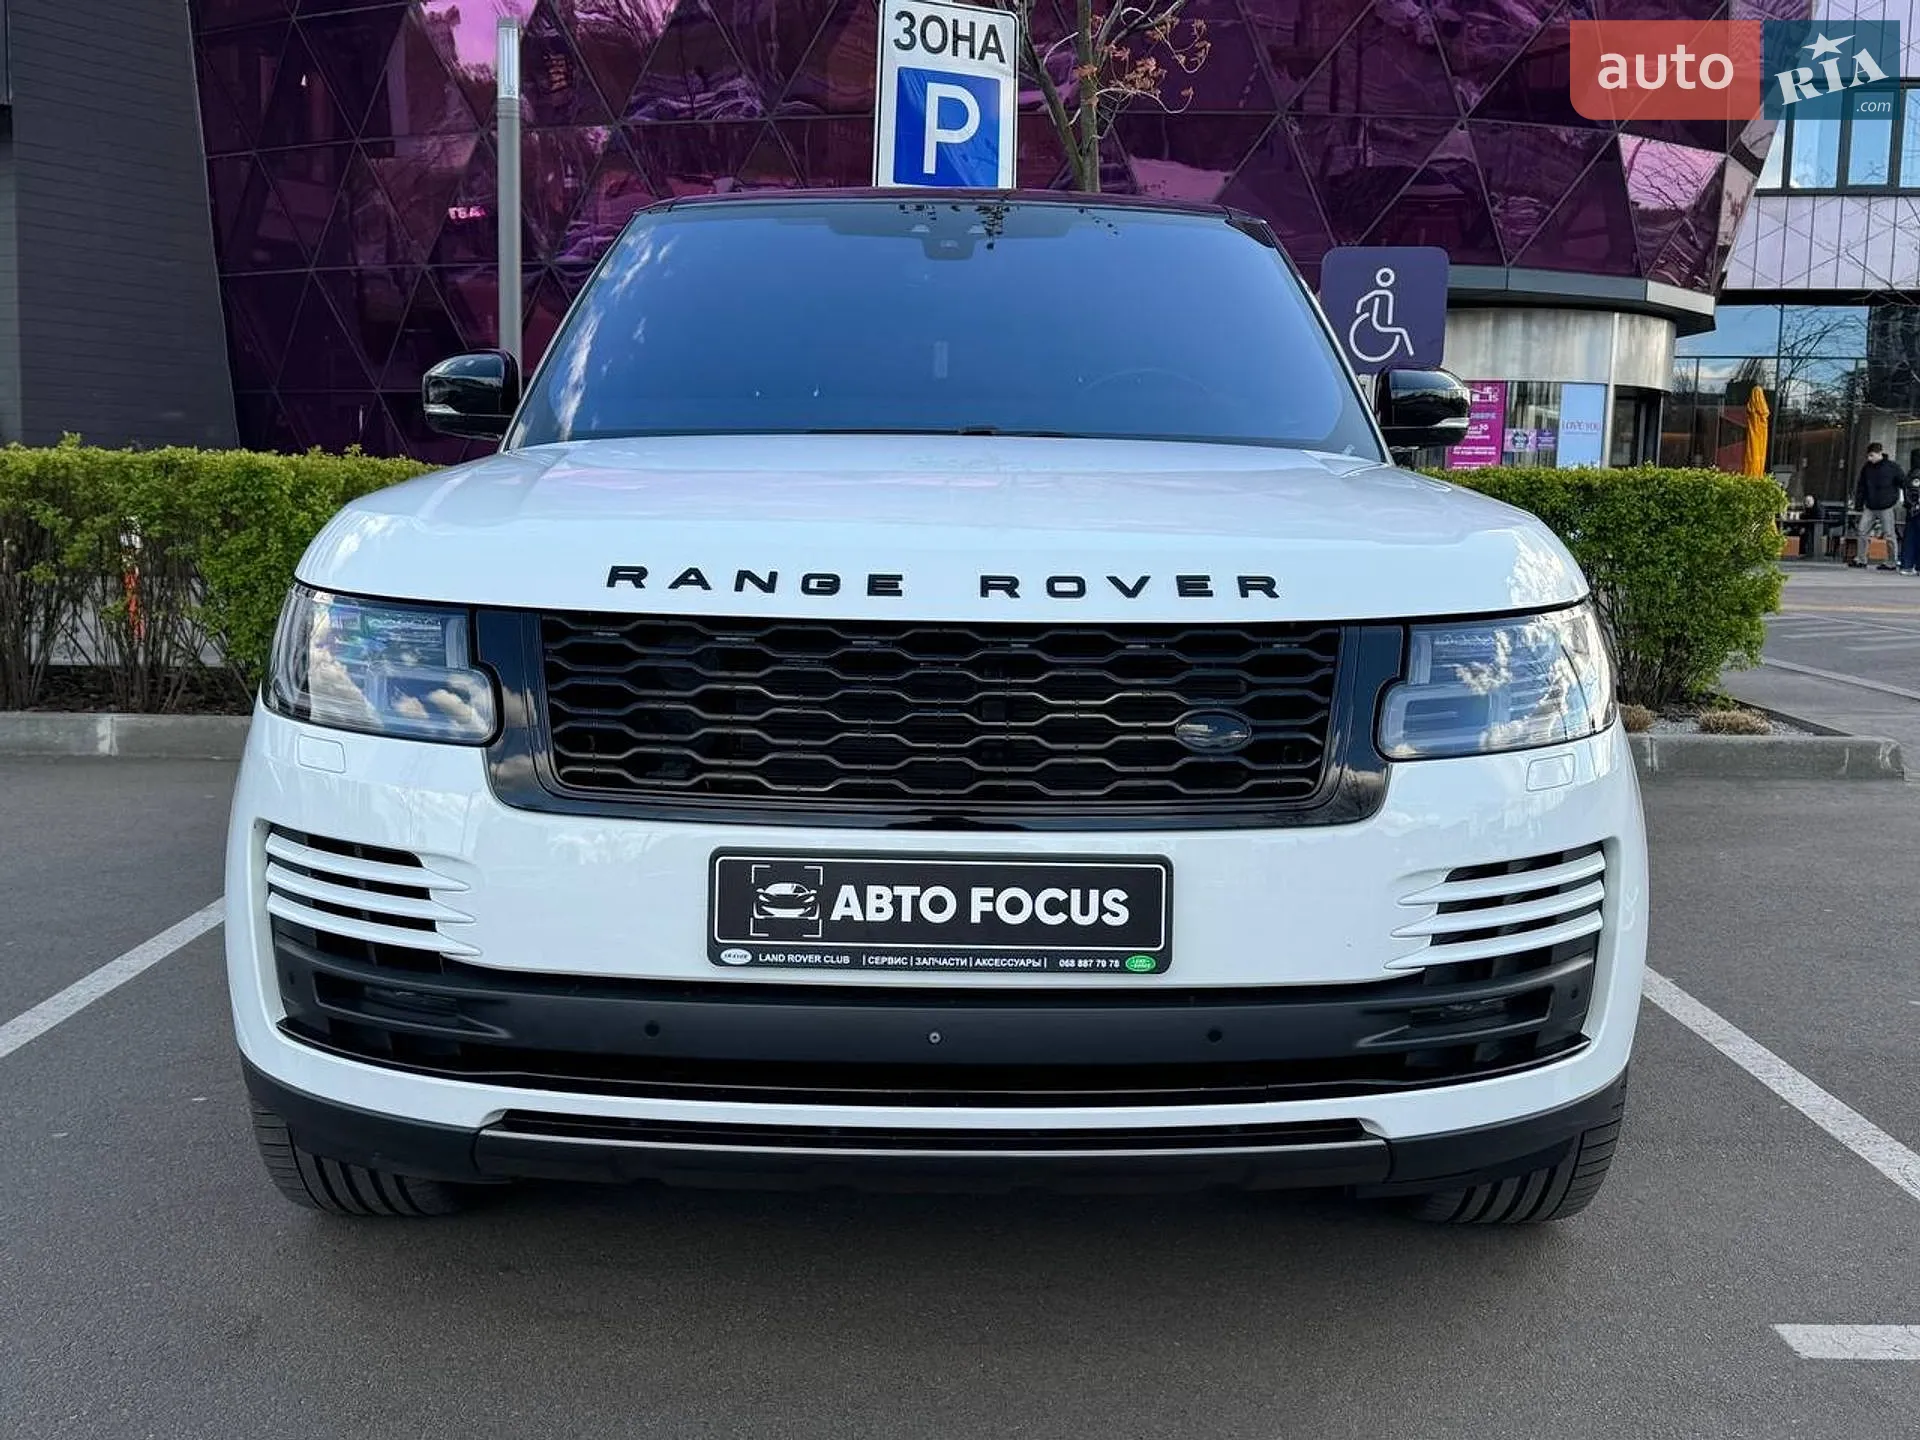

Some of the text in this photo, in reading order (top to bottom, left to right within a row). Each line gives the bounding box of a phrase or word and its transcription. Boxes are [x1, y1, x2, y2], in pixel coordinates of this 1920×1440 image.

[893, 10, 1006, 64] ЗОНА
[923, 82, 981, 175] P
[606, 565, 1281, 600] RANGE ROVER
[830, 885, 1130, 926] АВТО FOCUS
[758, 953, 786, 963] LAND
[787, 954, 822, 964] ROVER
[823, 955, 850, 965] CLUB
